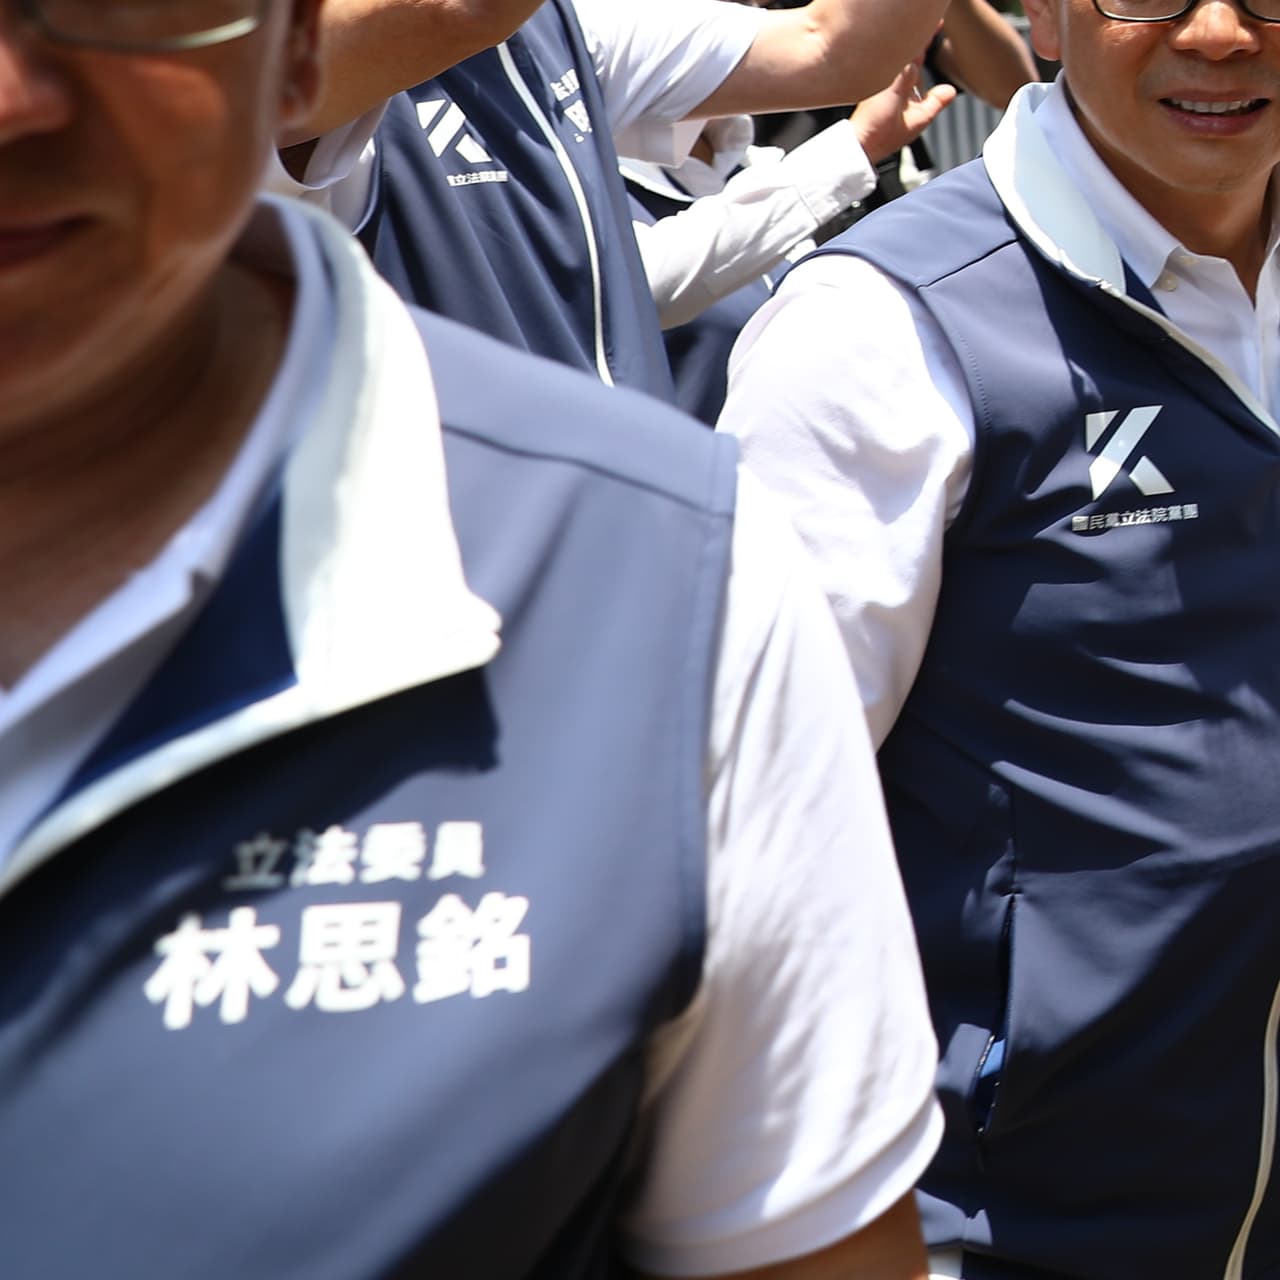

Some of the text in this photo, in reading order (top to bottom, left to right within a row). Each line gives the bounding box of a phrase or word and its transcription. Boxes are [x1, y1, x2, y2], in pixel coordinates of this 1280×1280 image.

[223, 820, 486, 890] 立法委員
[143, 891, 532, 1031] 林思銘
